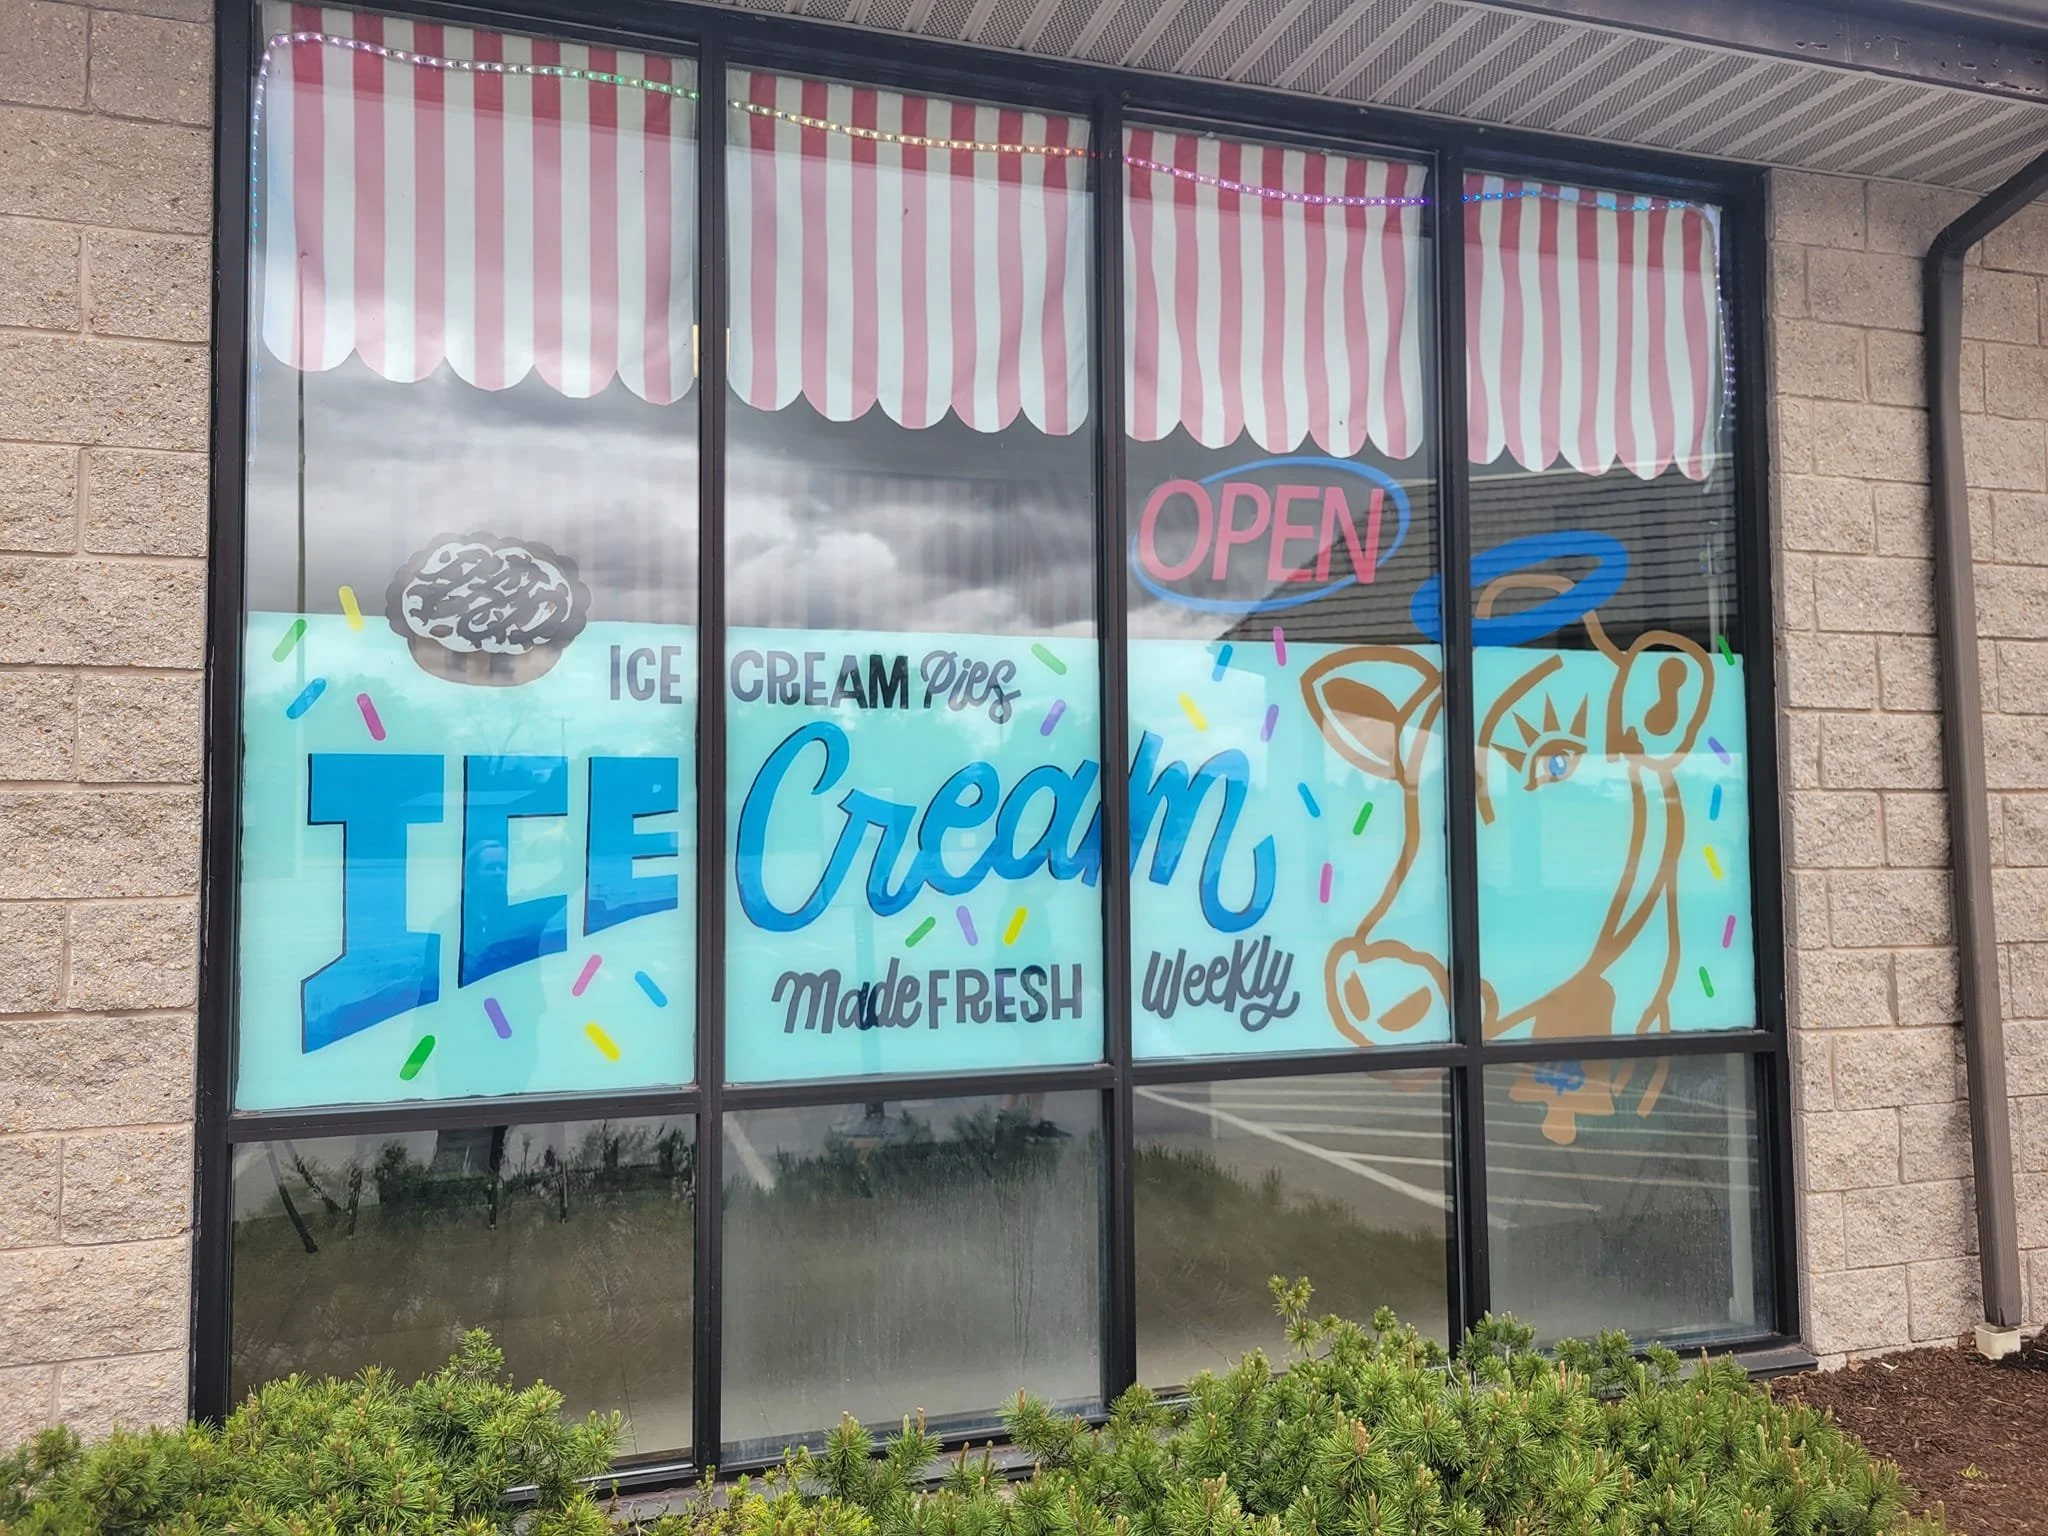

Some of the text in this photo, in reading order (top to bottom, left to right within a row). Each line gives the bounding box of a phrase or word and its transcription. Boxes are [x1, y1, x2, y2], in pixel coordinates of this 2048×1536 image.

[1138, 479, 1384, 584] OPEN
[610, 645, 1022, 724] ICE CREAM Pies
[301, 720, 1276, 1054] ICE Cream
[771, 957, 922, 1034] Made
[928, 963, 1083, 1030] FRESH
